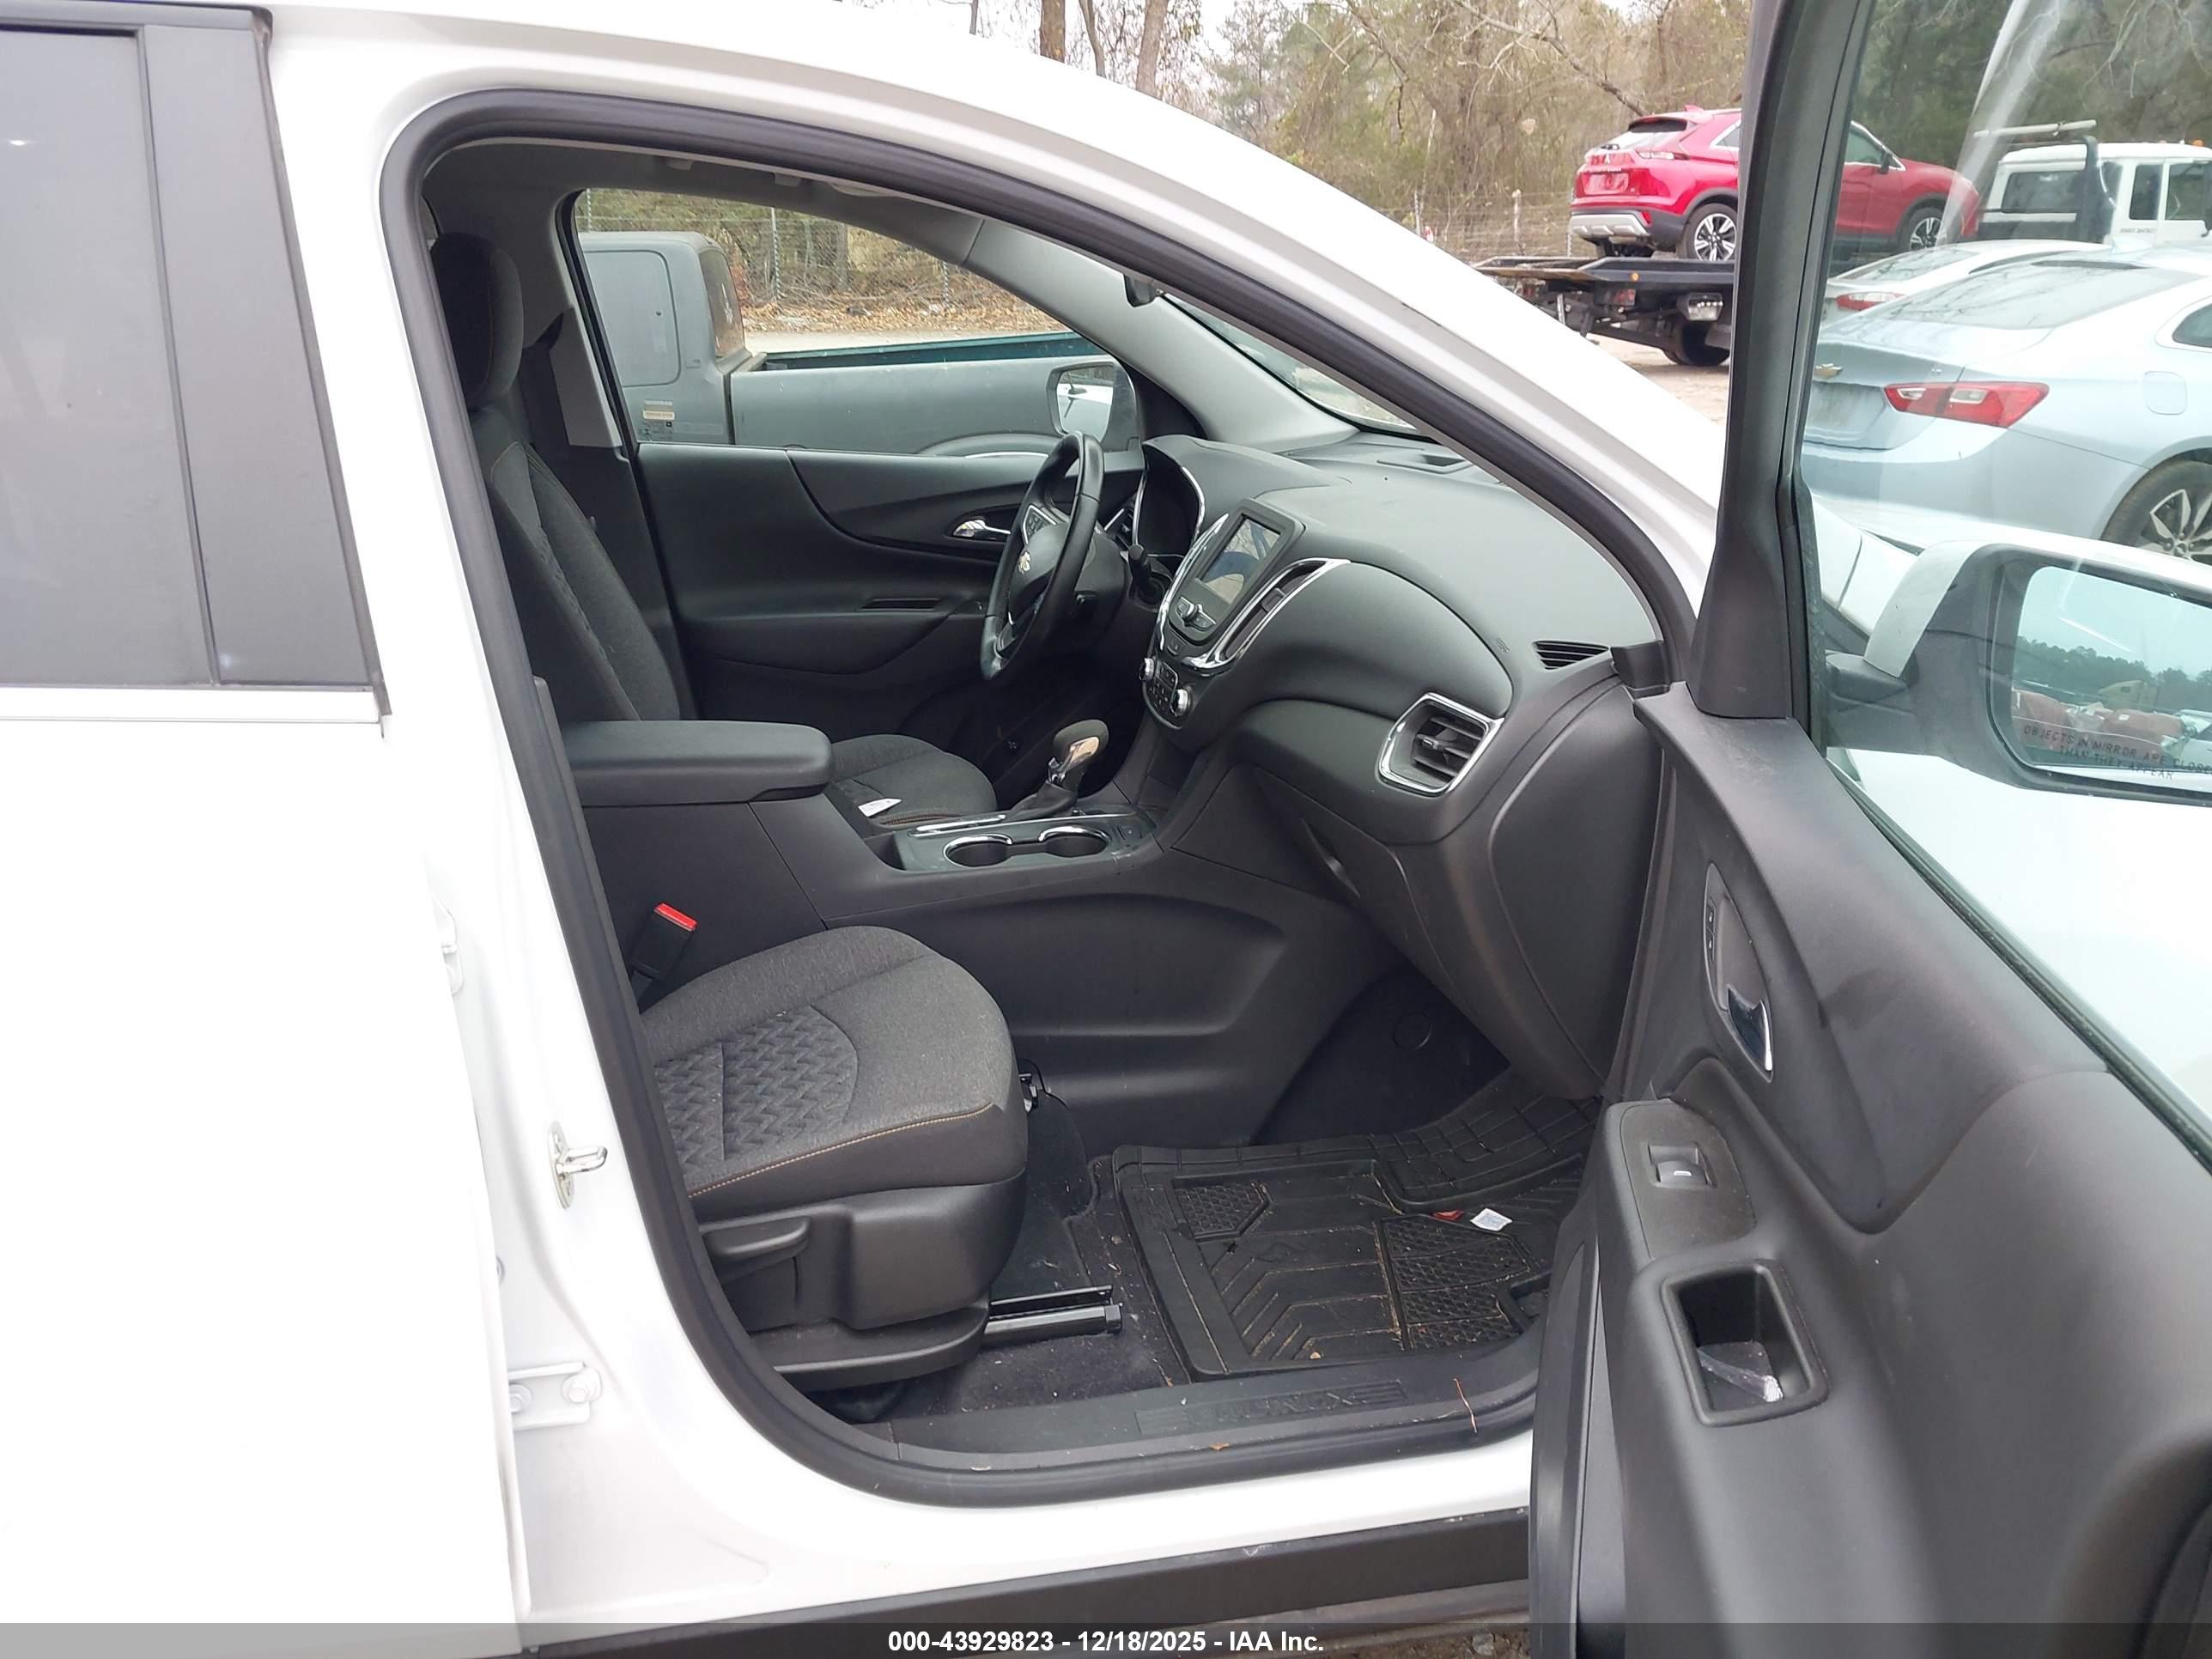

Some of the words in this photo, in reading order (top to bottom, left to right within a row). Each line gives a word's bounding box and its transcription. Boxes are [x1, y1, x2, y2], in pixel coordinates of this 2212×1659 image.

[2024, 726, 2074, 744] OBJECTS
[2076, 736, 2089, 748] IN
[2092, 741, 2137, 759] MIRROR
[2143, 752, 2166, 765] ARE
[2060, 745, 2088, 760] THAN
[2094, 754, 2122, 768] THEY
